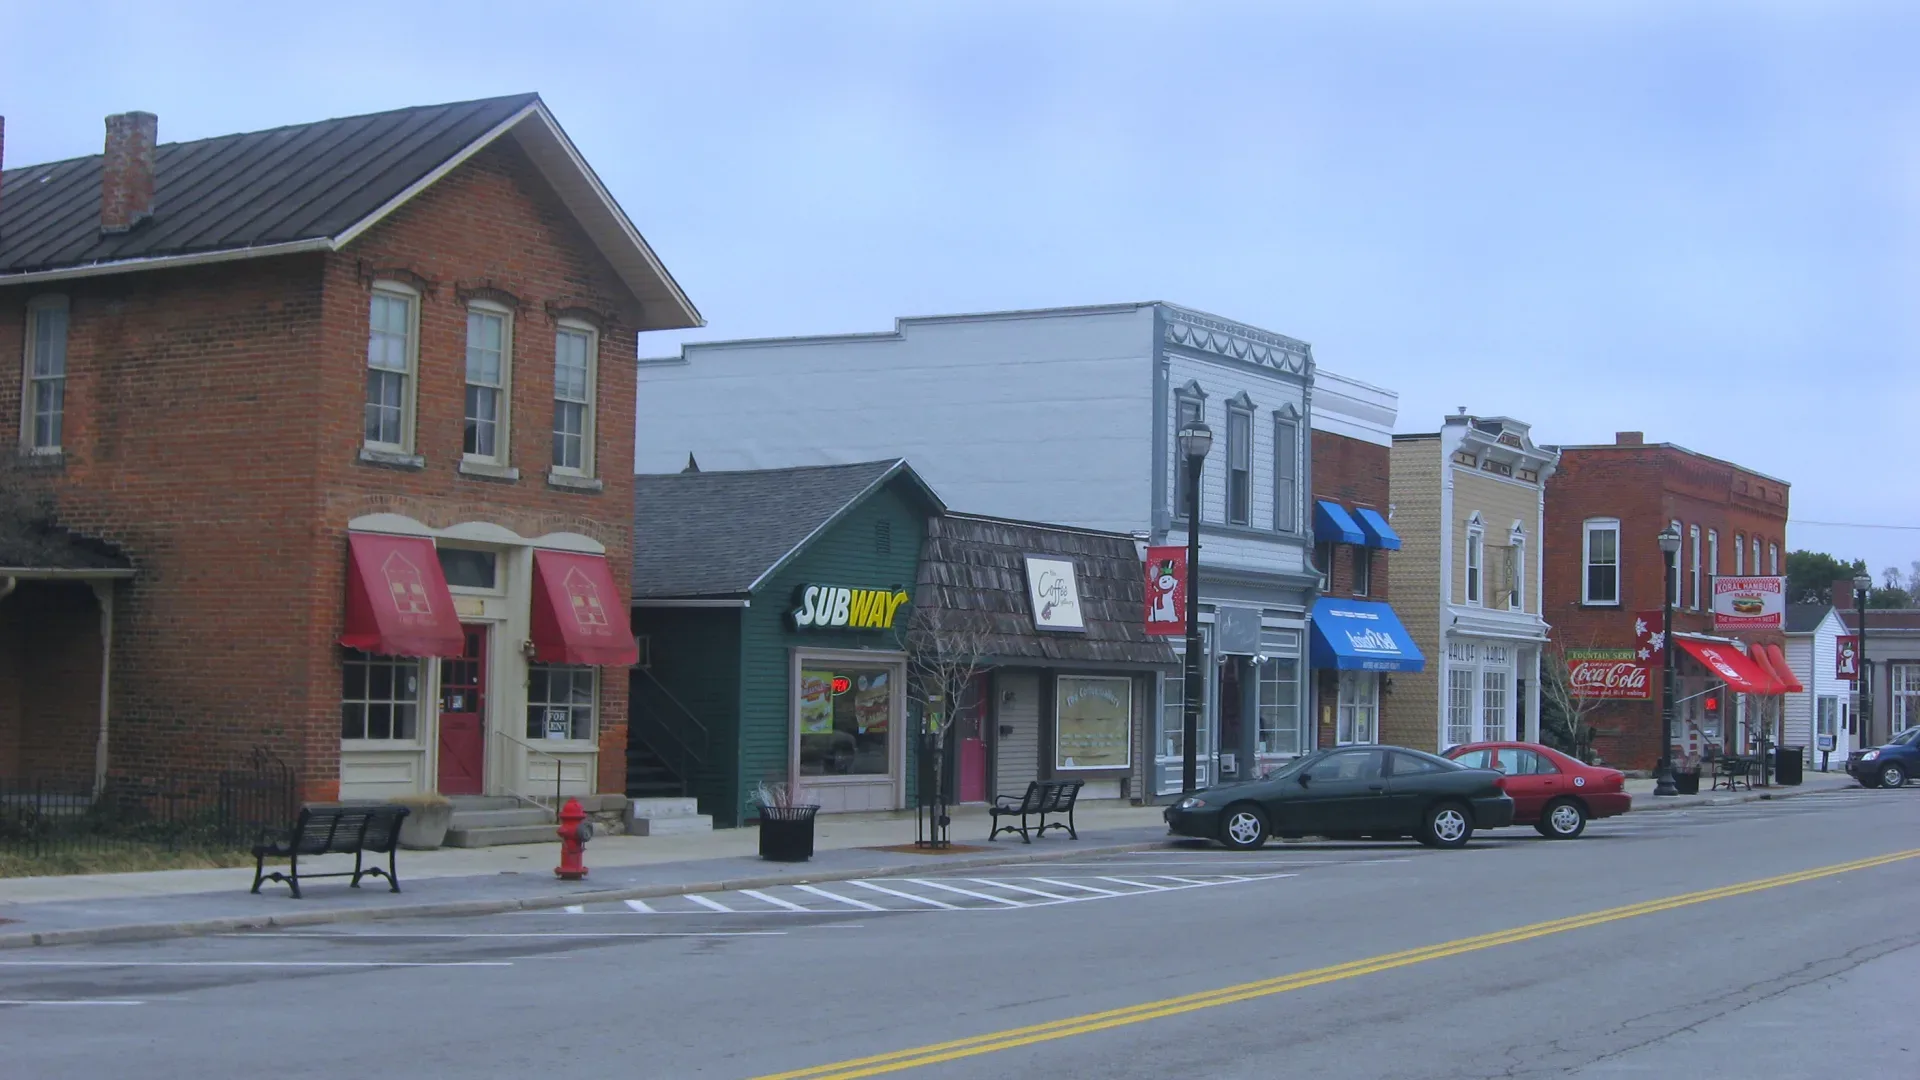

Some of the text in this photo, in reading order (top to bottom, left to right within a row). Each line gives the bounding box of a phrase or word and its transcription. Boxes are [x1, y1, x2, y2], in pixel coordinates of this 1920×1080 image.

[1038, 571, 1068, 607] Coffee
[1717, 582, 1778, 593] KORAL HAMBURG
[795, 586, 909, 627] SUBWAY
[1449, 643, 1464, 661] HALL
[1466, 644, 1475, 661] OF
[1614, 651, 1636, 659] SERVI
[1570, 662, 1646, 688] Coca-Cola
[832, 680, 849, 692] PEN
[549, 712, 565, 721] FOR
